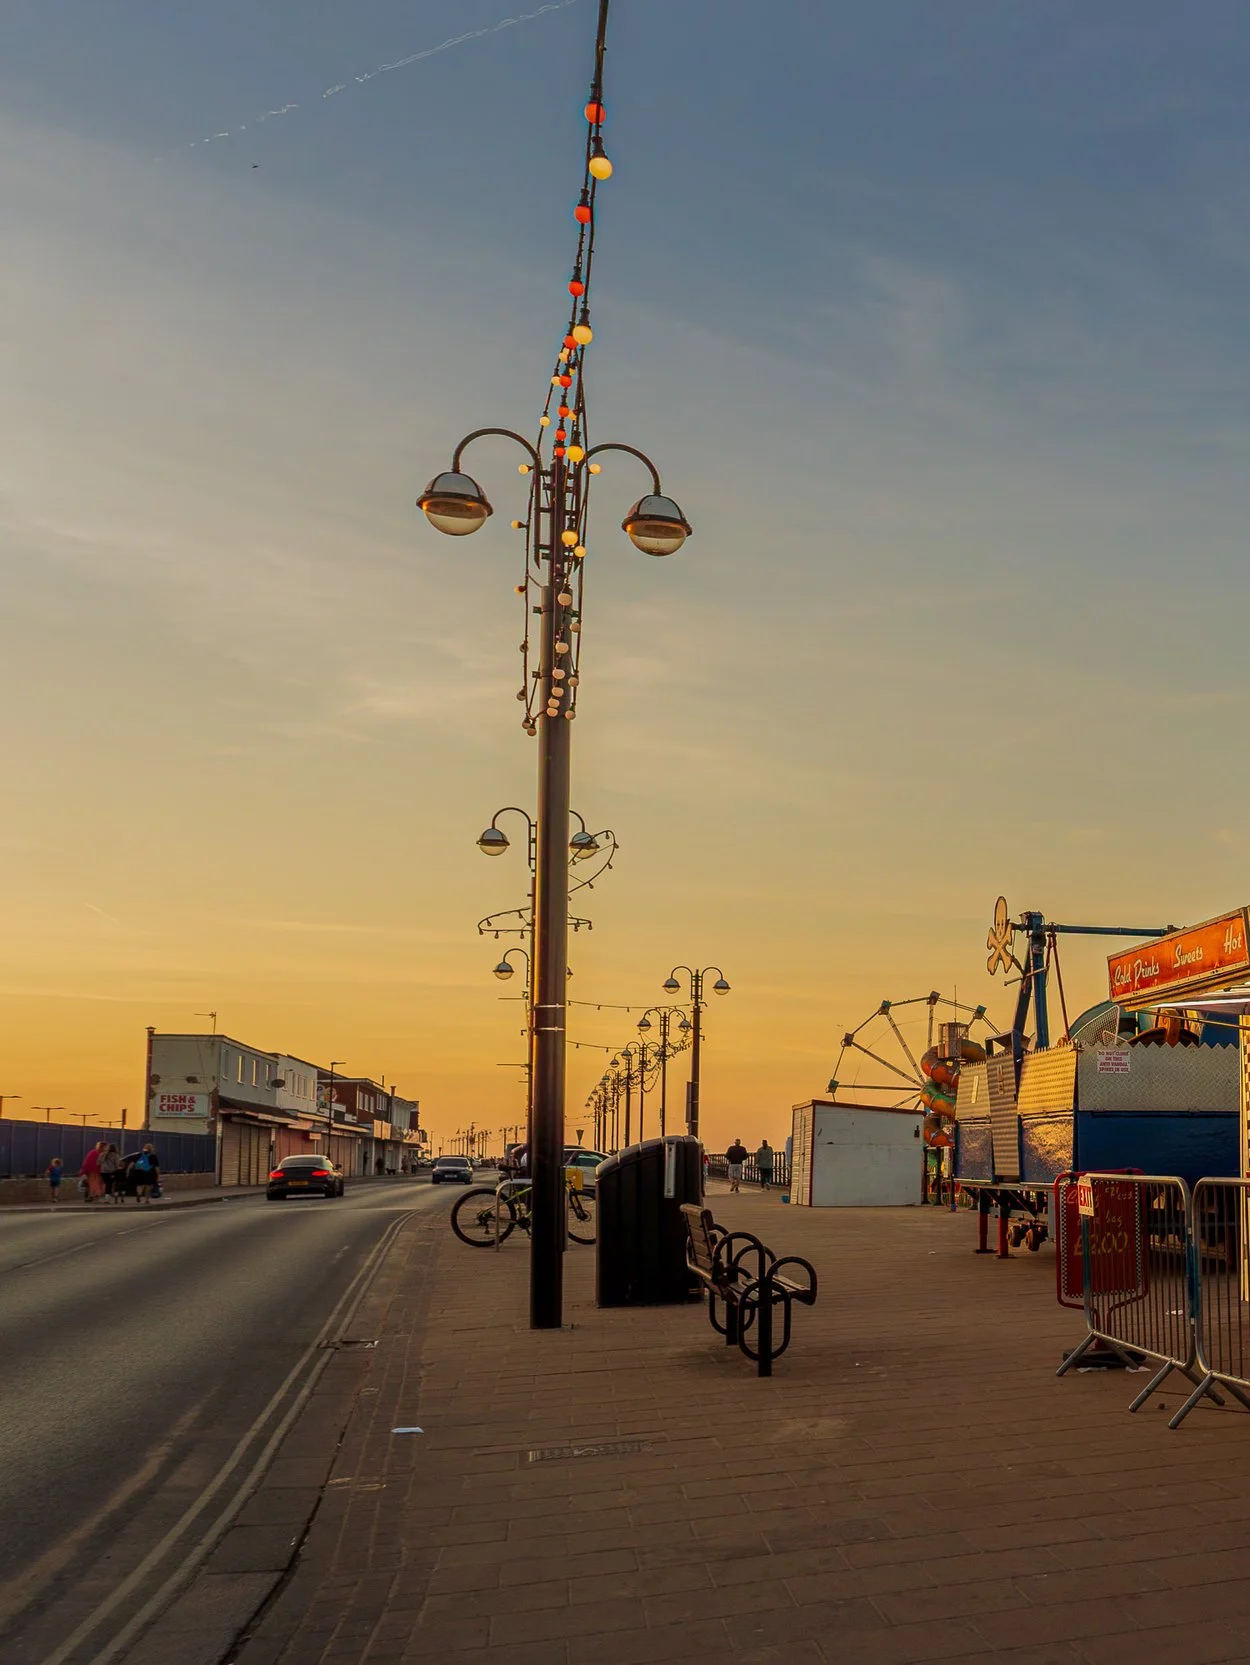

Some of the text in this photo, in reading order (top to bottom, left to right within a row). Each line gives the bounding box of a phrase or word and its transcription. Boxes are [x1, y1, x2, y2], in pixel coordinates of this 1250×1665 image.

[1114, 924, 1243, 989] Cold Drinks Sweets Hot
[160, 1094, 196, 1104] FISH &
[159, 1103, 195, 1112] CHIPS
